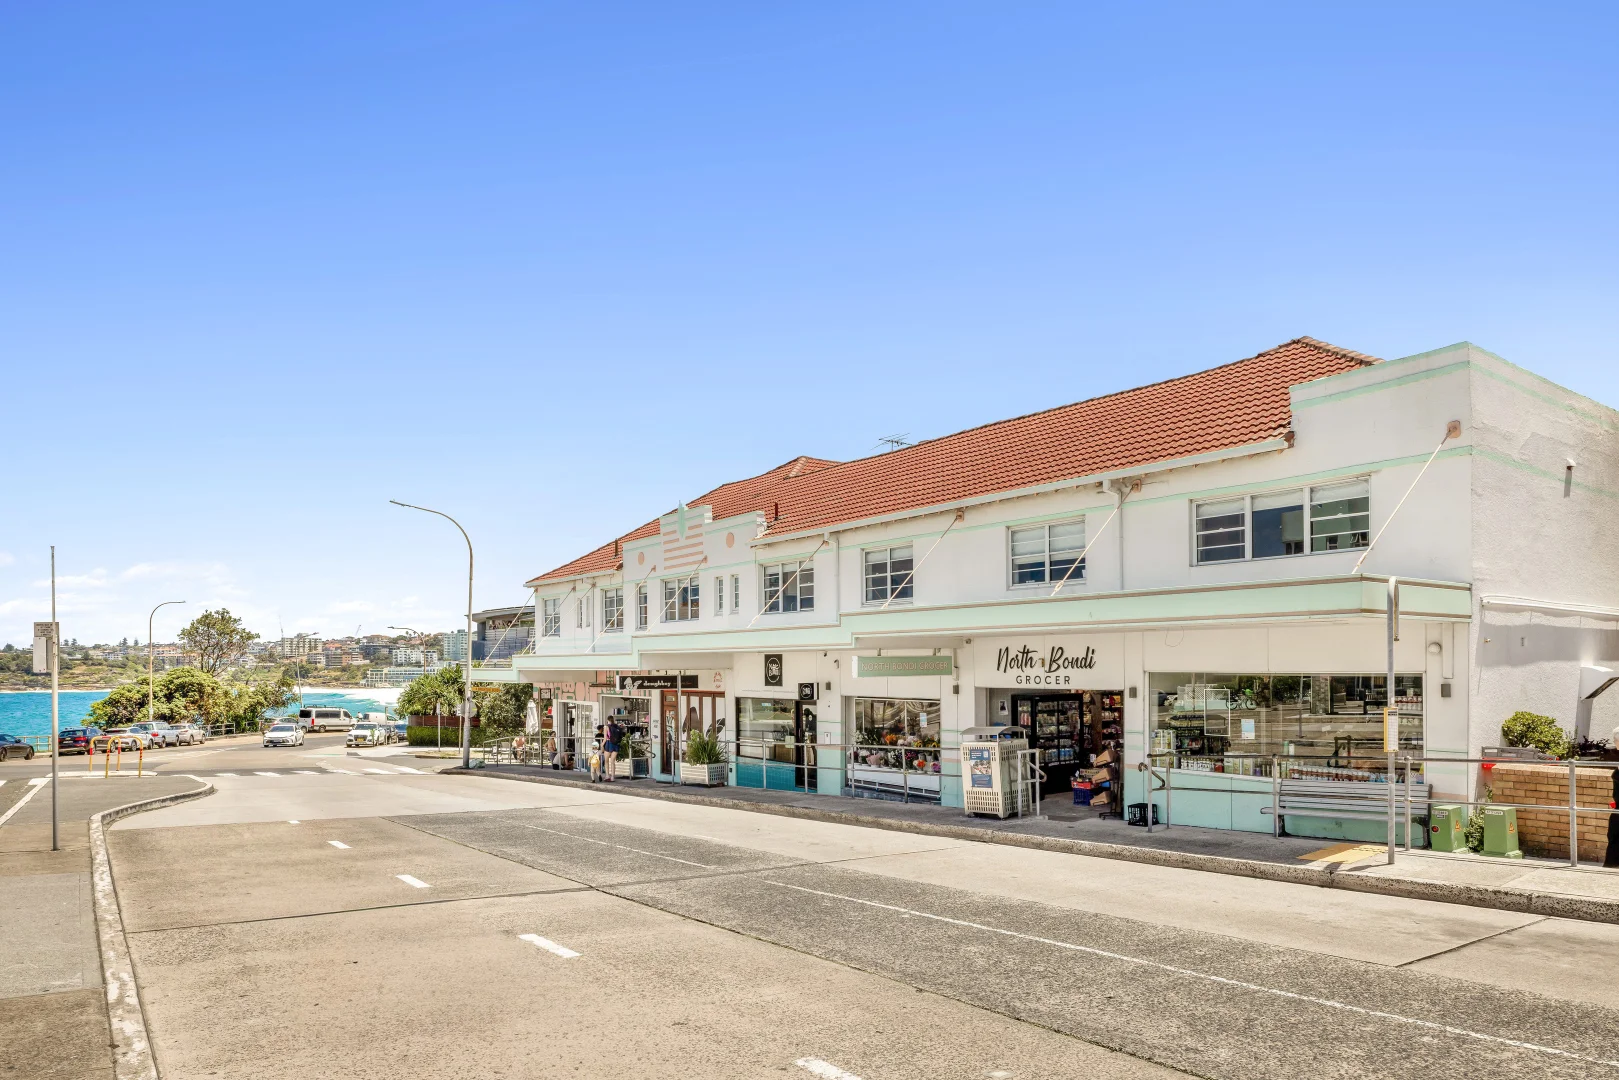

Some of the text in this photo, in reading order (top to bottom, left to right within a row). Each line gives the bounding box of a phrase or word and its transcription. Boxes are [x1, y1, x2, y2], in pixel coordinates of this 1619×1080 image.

[996, 644, 1096, 673] North Bondi
[861, 661, 948, 671] NORTH BONDI GROCER
[1016, 675, 1071, 684] GROCER
